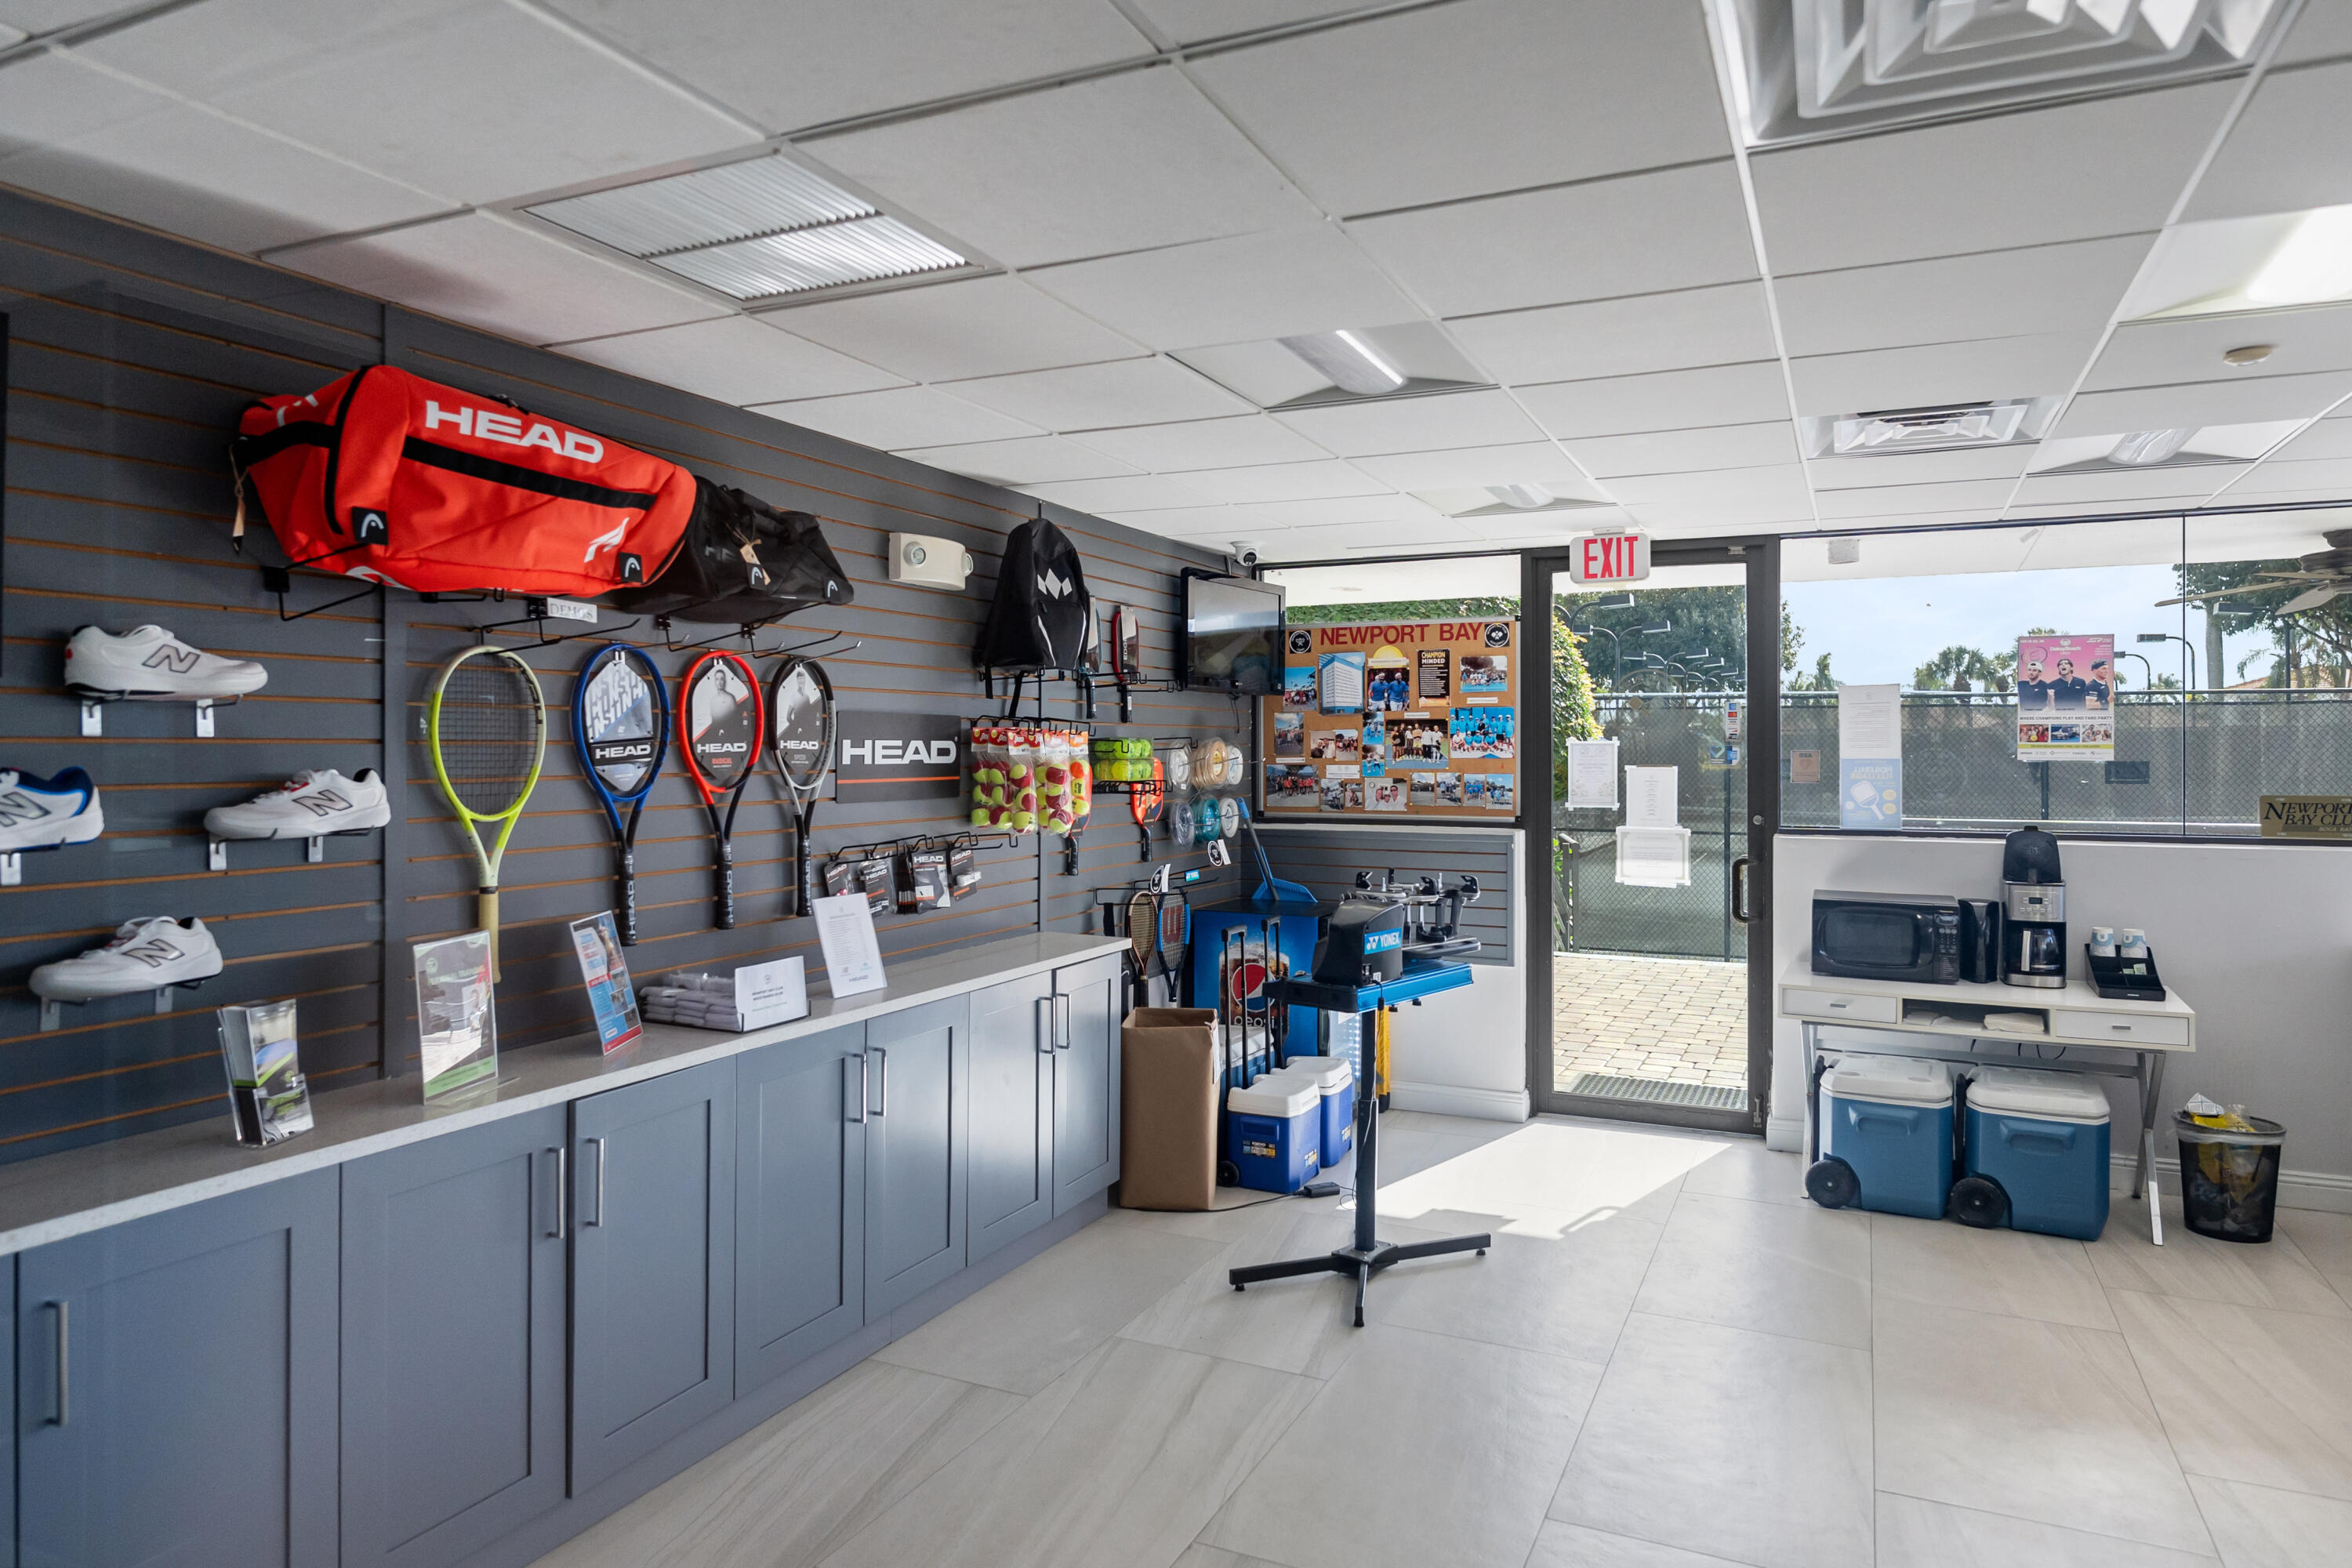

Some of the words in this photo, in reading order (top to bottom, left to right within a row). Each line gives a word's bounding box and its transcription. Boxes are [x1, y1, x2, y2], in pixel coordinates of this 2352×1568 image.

[426, 400, 604, 464] HEAD
[1584, 535, 1639, 579] EXIT
[1320, 624, 1429, 645] NEWPORT
[1439, 622, 1484, 641] BAY
[596, 744, 651, 759] HEAD
[697, 742, 746, 753] HEAD
[780, 740, 818, 750] HEAD
[842, 739, 956, 764] HEAD
[2285, 815, 2317, 825] BAY
[952, 850, 971, 862] HEAD
[827, 863, 848, 878] HEAD
[866, 869, 887, 880] HEAD
[627, 880, 637, 935] HEAD
[1380, 931, 1399, 947] YONEX
